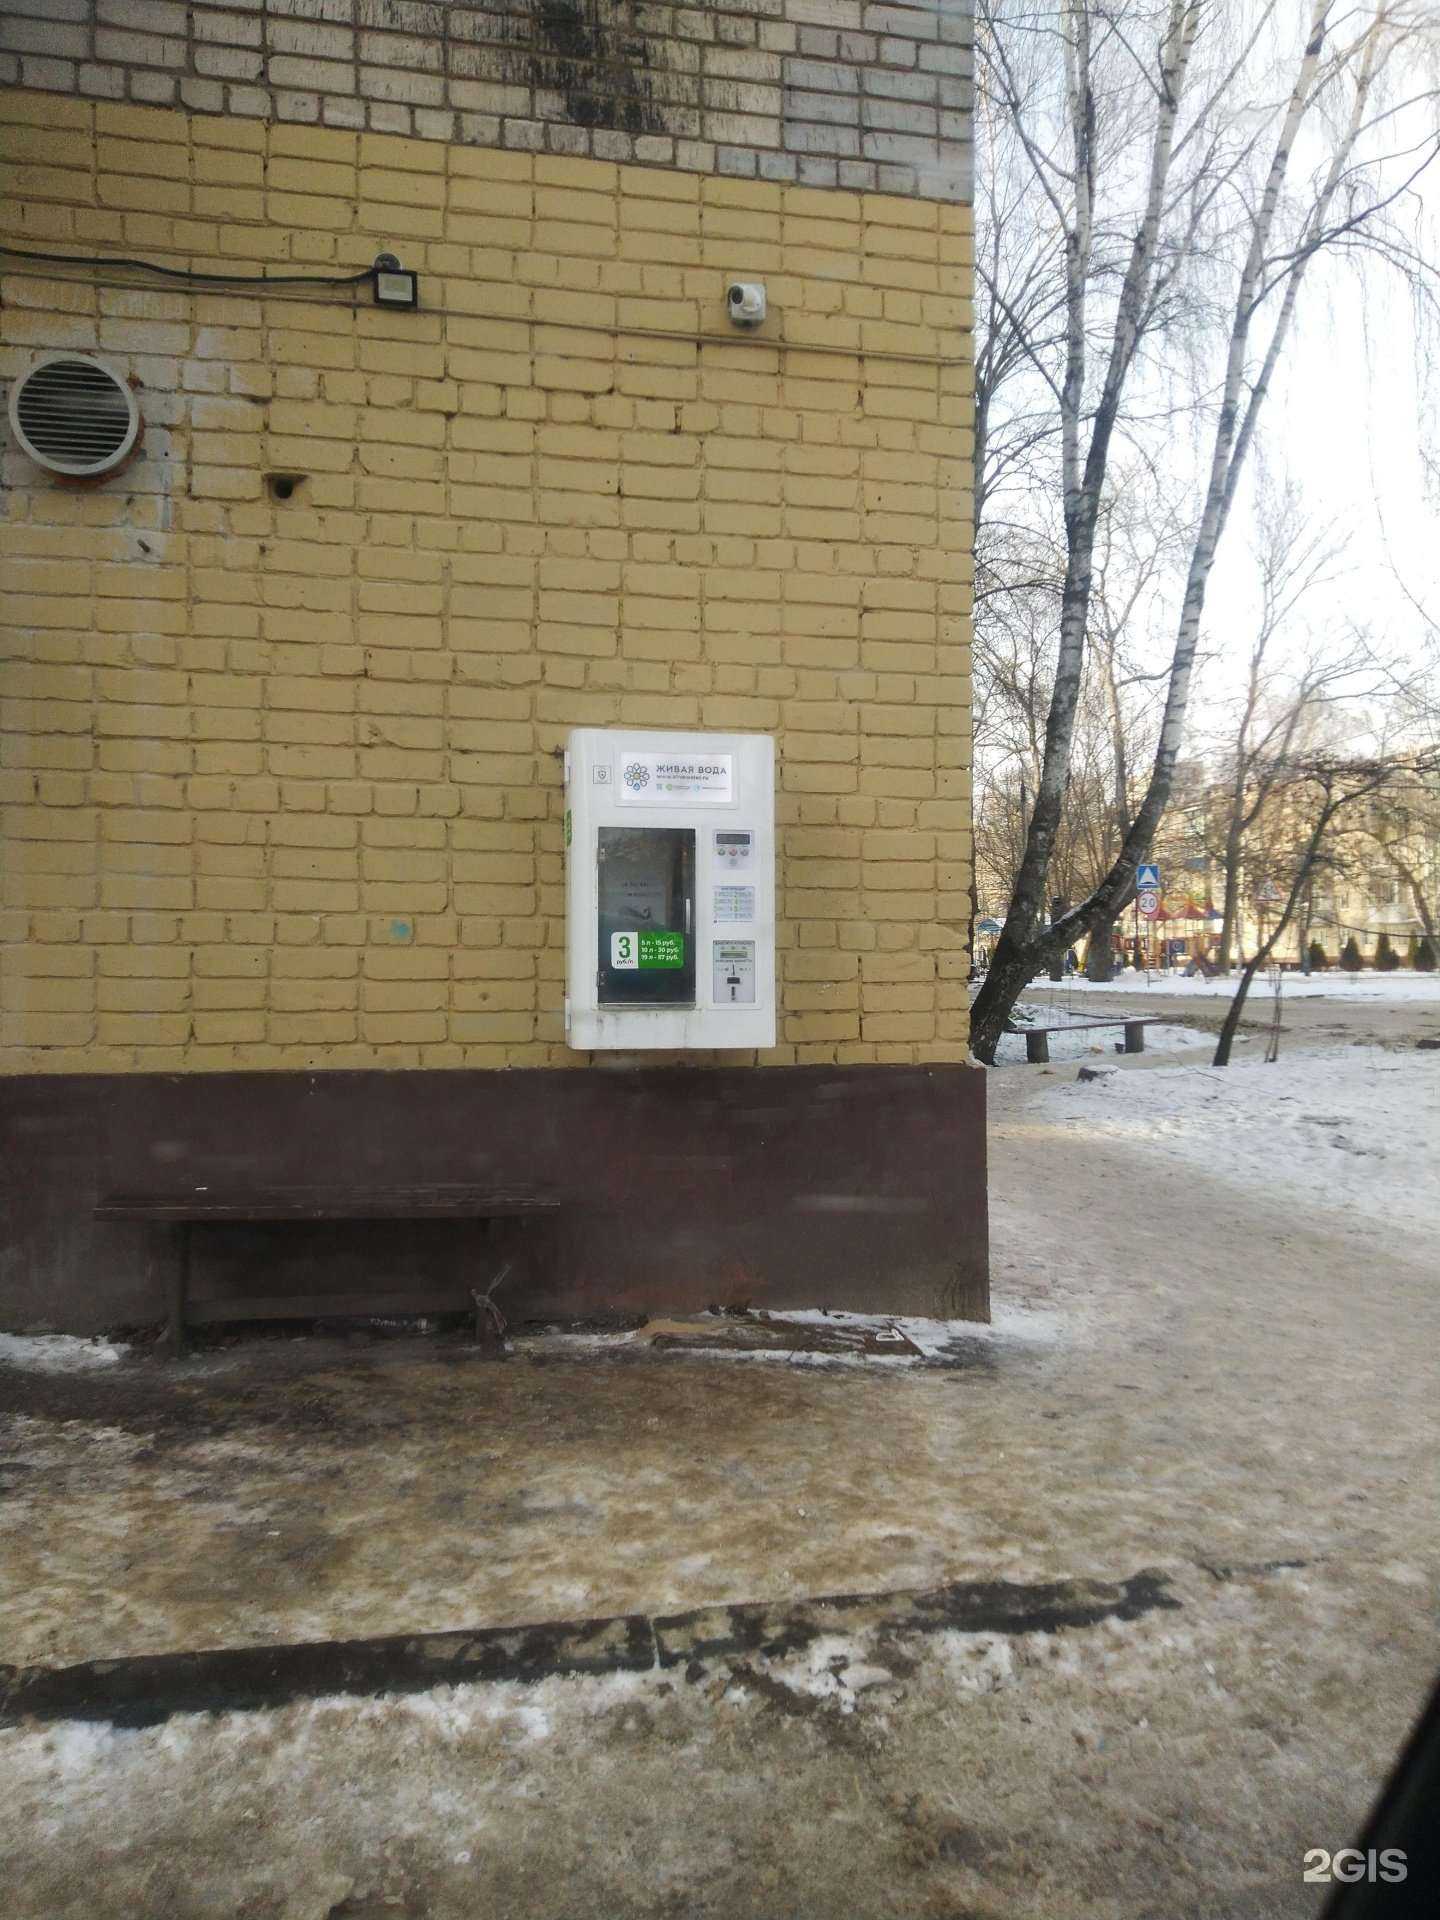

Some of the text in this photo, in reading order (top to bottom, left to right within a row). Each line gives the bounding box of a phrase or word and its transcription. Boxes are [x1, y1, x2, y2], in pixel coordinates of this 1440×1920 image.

[656, 765, 727, 775] ЖИВАЯ ВОДА
[1142, 898, 1155, 908] 20
[618, 936, 631, 958] 3
